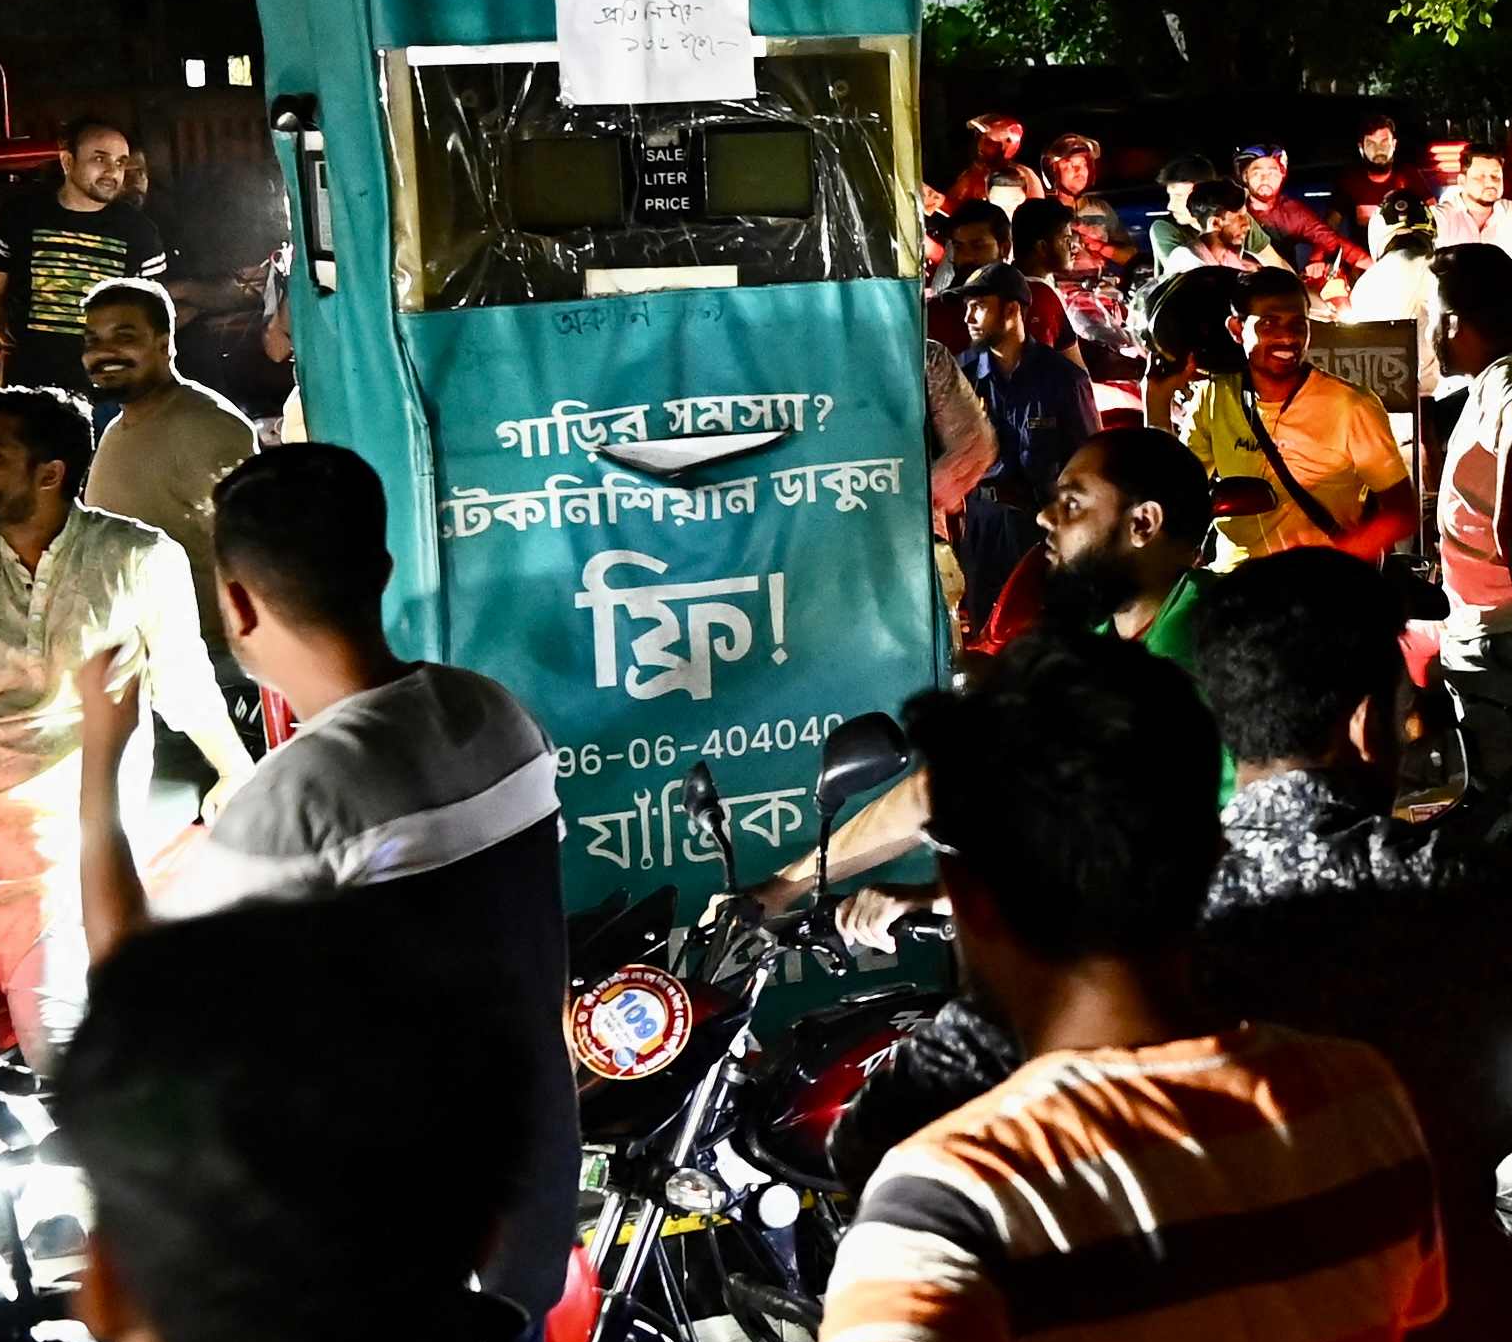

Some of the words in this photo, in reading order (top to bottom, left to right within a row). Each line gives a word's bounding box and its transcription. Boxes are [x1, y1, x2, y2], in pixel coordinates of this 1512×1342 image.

[645, 148, 685, 162] SALE
[644, 172, 688, 186] LITER
[644, 197, 691, 211] PRICE
[769, 457, 905, 512] ডাকুন
